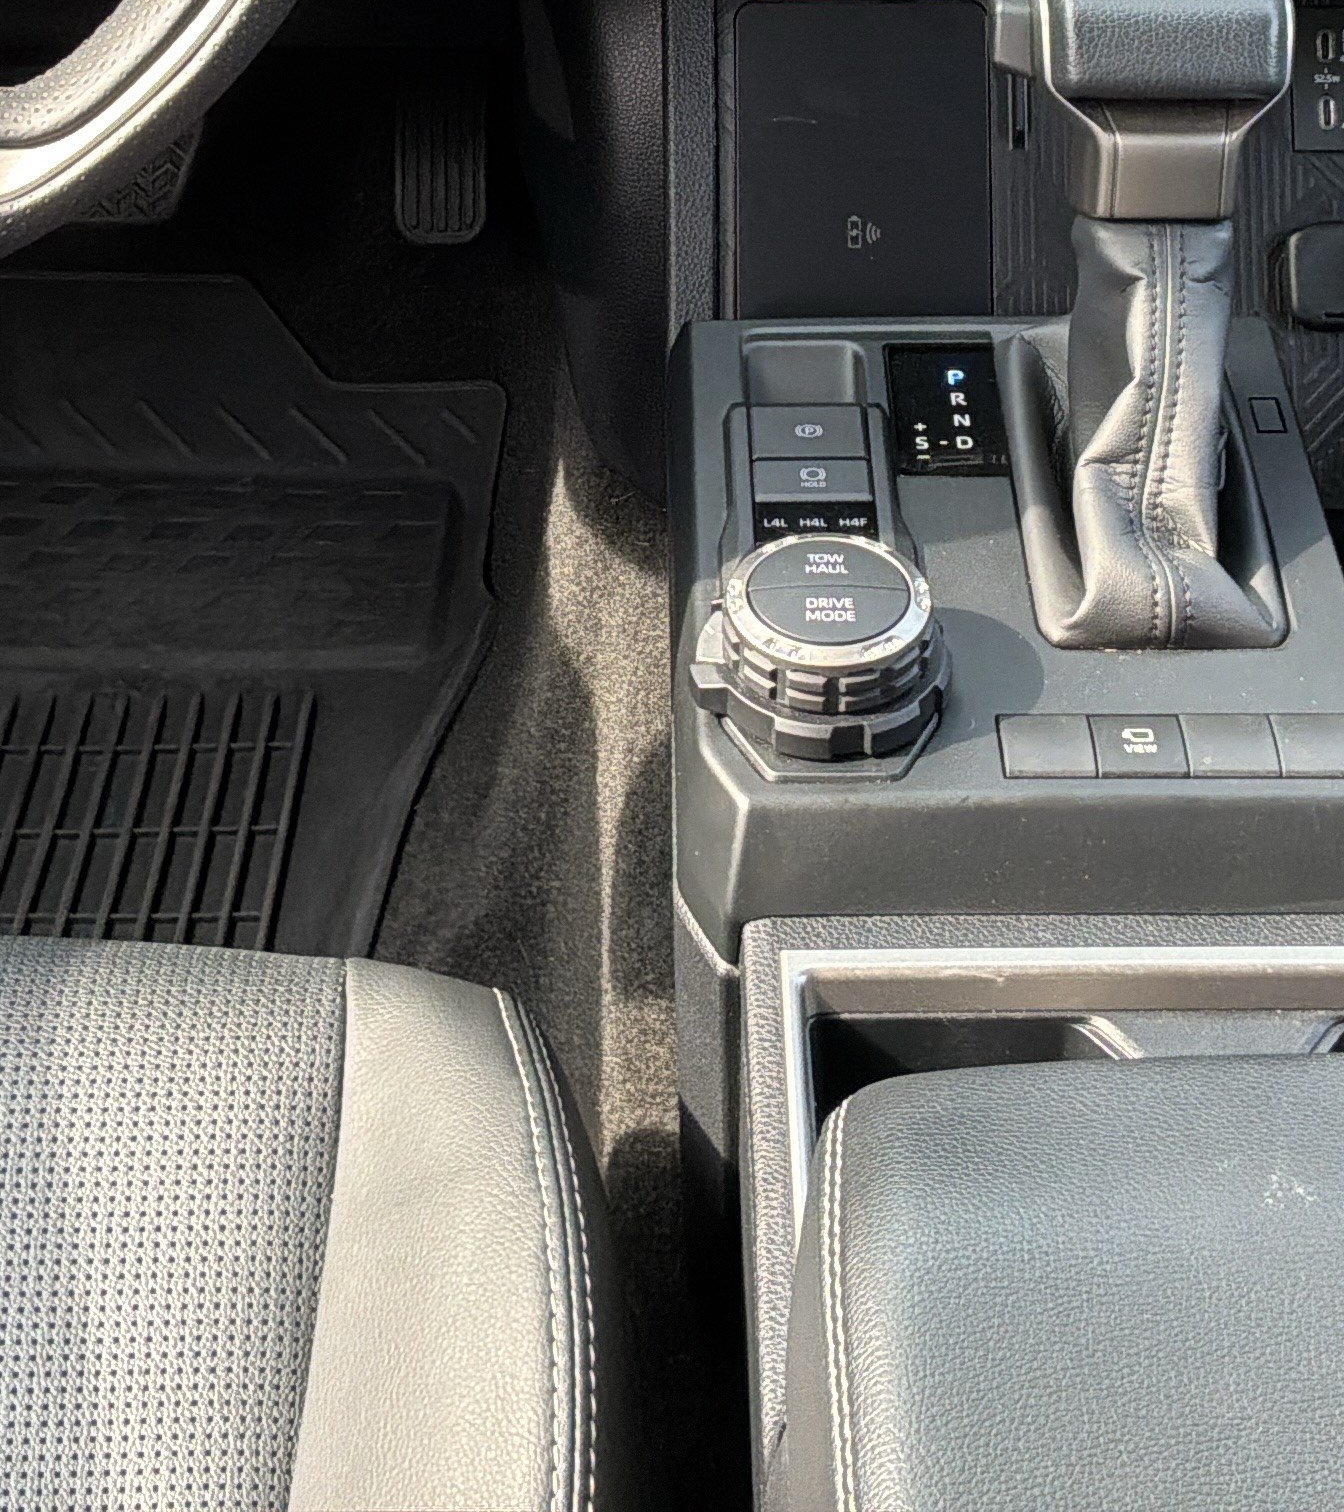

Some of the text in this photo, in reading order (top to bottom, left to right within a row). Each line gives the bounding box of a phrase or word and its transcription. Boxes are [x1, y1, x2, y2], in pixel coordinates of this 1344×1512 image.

[947, 368, 965, 386] P
[950, 391, 967, 406] R
[953, 413, 971, 427] N
[915, 435, 974, 450] S D
[800, 480, 827, 488] HOLD
[763, 517, 868, 528] L4L H4L H4F
[806, 553, 845, 564] TOW
[805, 564, 849, 575] HAUL
[805, 597, 855, 609] DRIVE
[805, 610, 856, 622] MODE
[1123, 743, 1158, 754] VIEW
